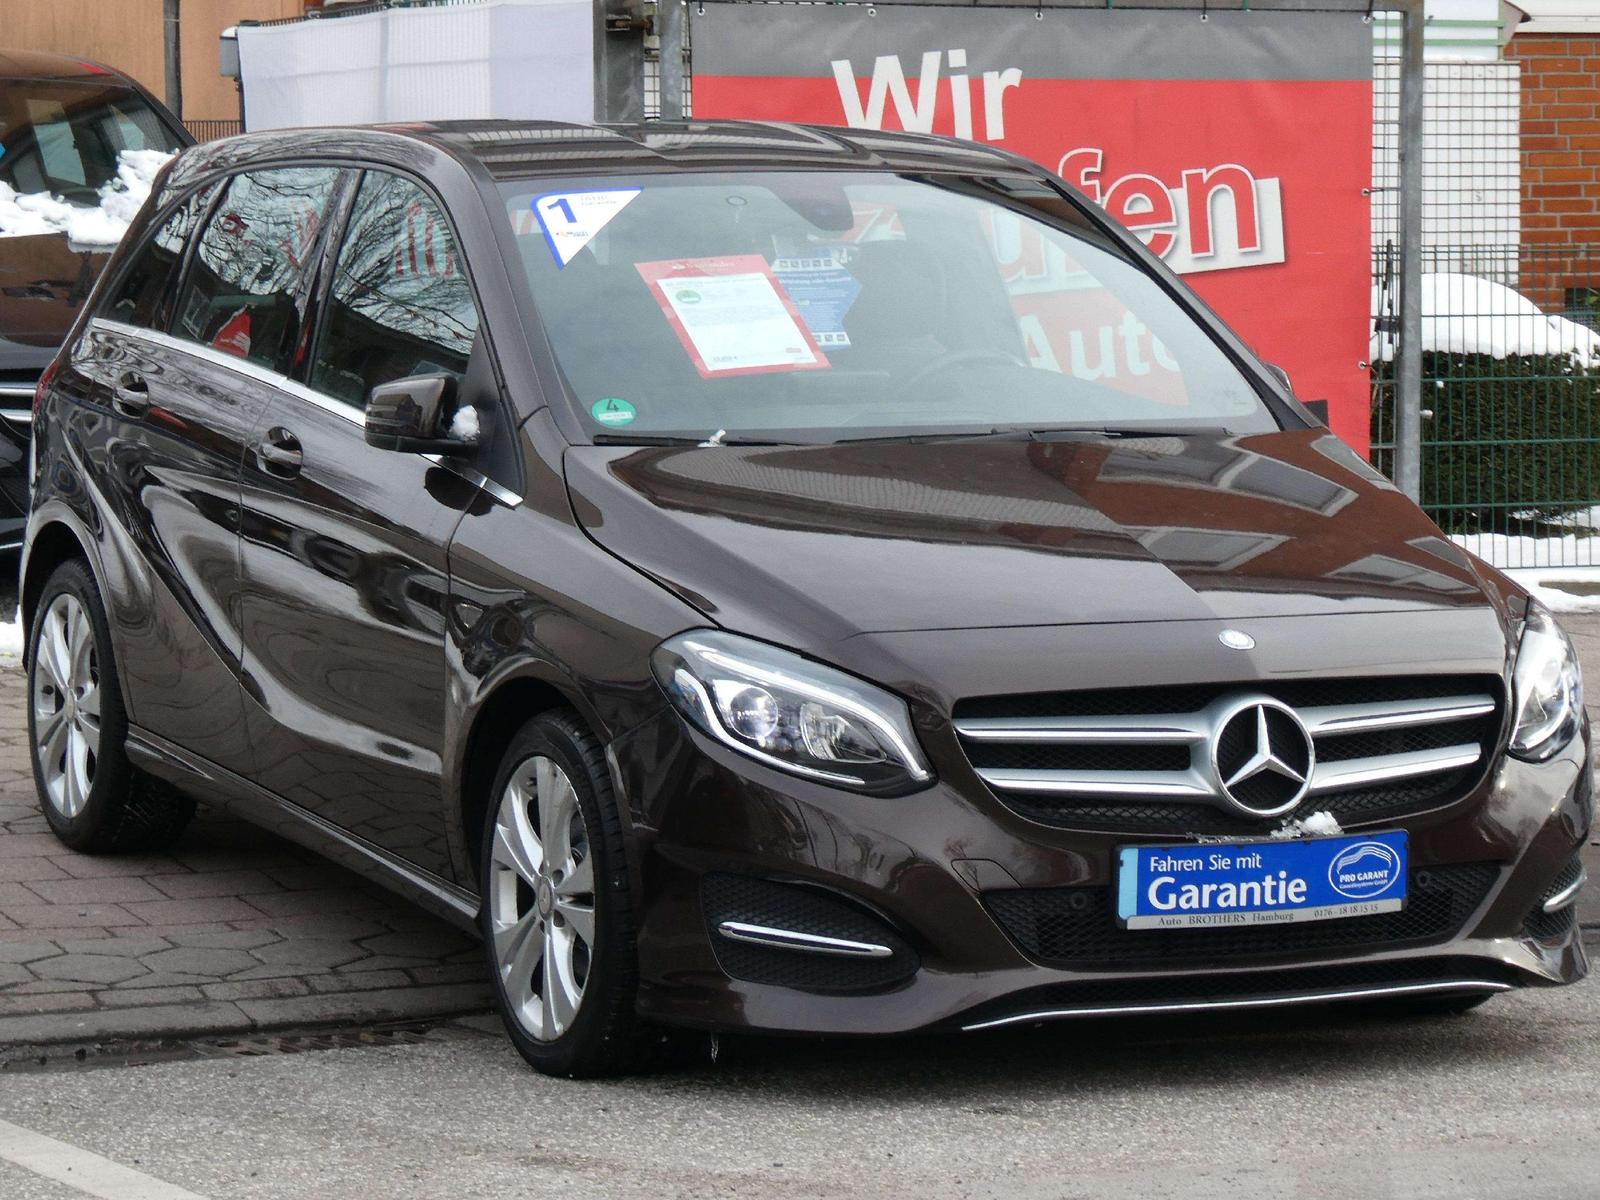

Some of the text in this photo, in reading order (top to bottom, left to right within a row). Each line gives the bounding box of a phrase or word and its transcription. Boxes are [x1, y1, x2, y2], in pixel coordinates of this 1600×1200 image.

[831, 49, 1023, 141] Wir
[546, 198, 578, 223] 1
[606, 399, 620, 412] 4
[1150, 852, 1262, 872] Fahren Sie mit
[1340, 869, 1389, 883] PRO GARANT
[1148, 870, 1307, 910] Garantie
[1158, 917, 1182, 926] Auto
[1188, 913, 1246, 925] BROTHERS
[1252, 911, 1295, 923] Hamburg
